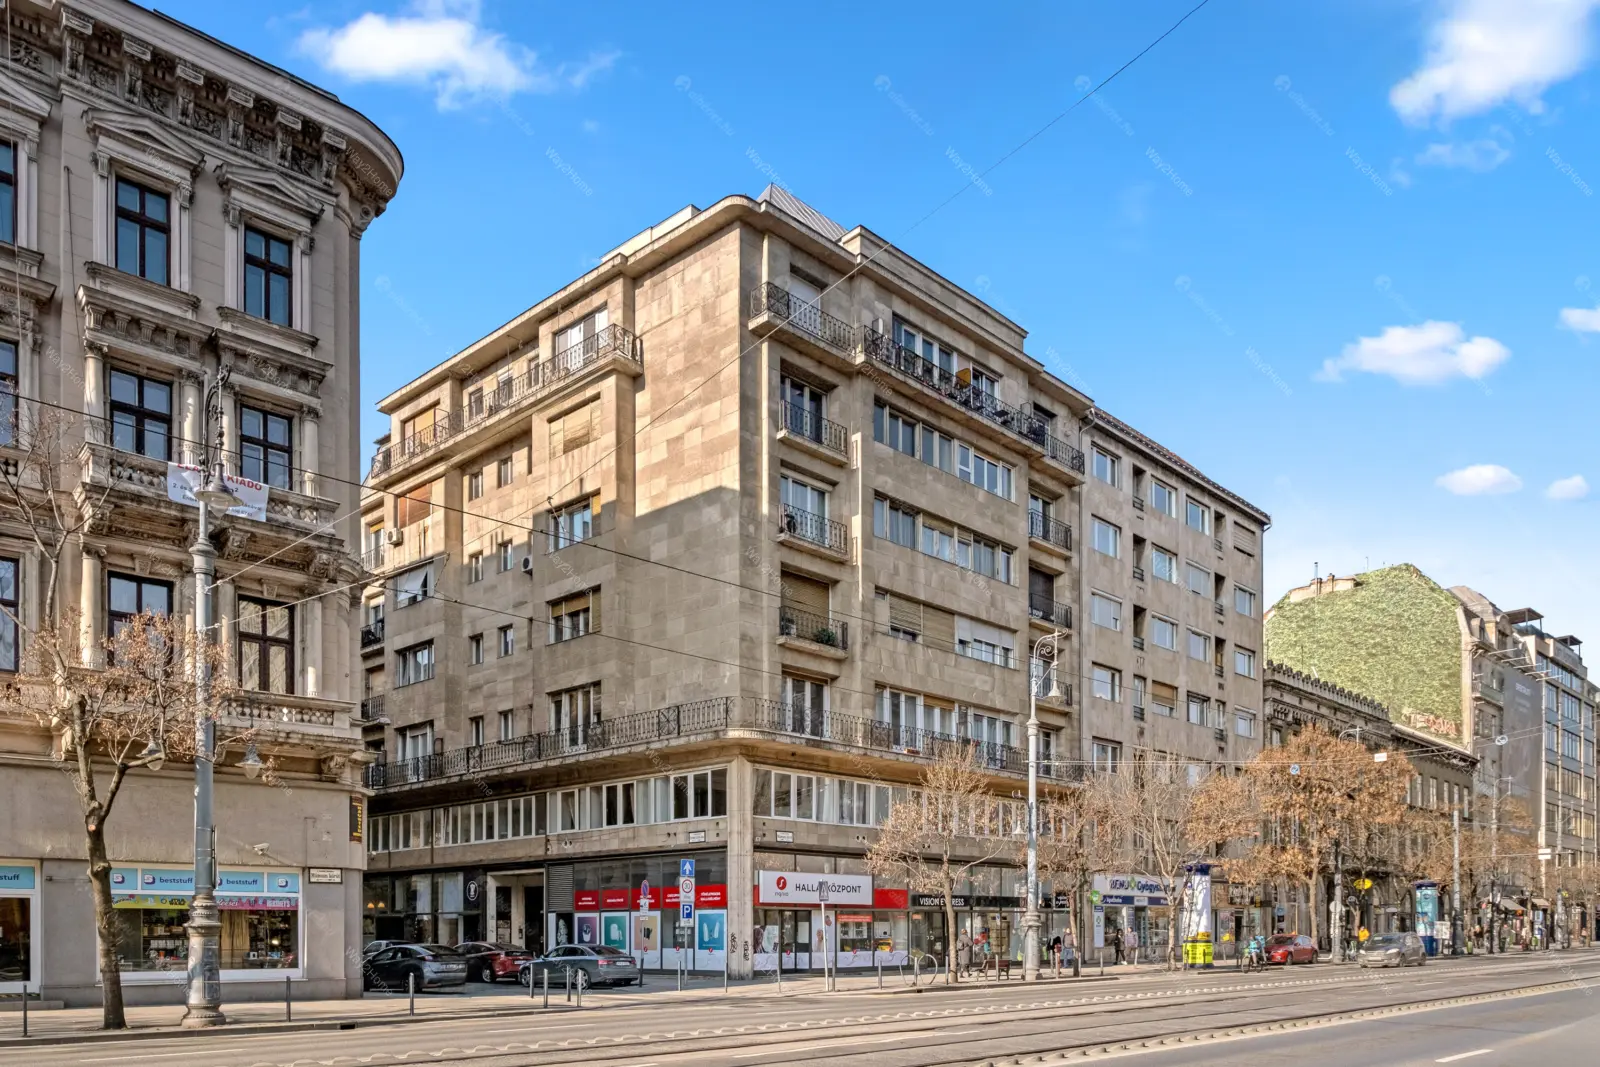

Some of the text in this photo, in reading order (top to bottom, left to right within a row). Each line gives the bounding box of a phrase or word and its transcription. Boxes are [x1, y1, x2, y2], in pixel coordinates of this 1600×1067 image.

[159, 876, 193, 884] beststuff
[226, 878, 258, 886] beststuff
[795, 883, 862, 894] HALLKÖZPONT
[919, 897, 965, 906] VISION ERESS
